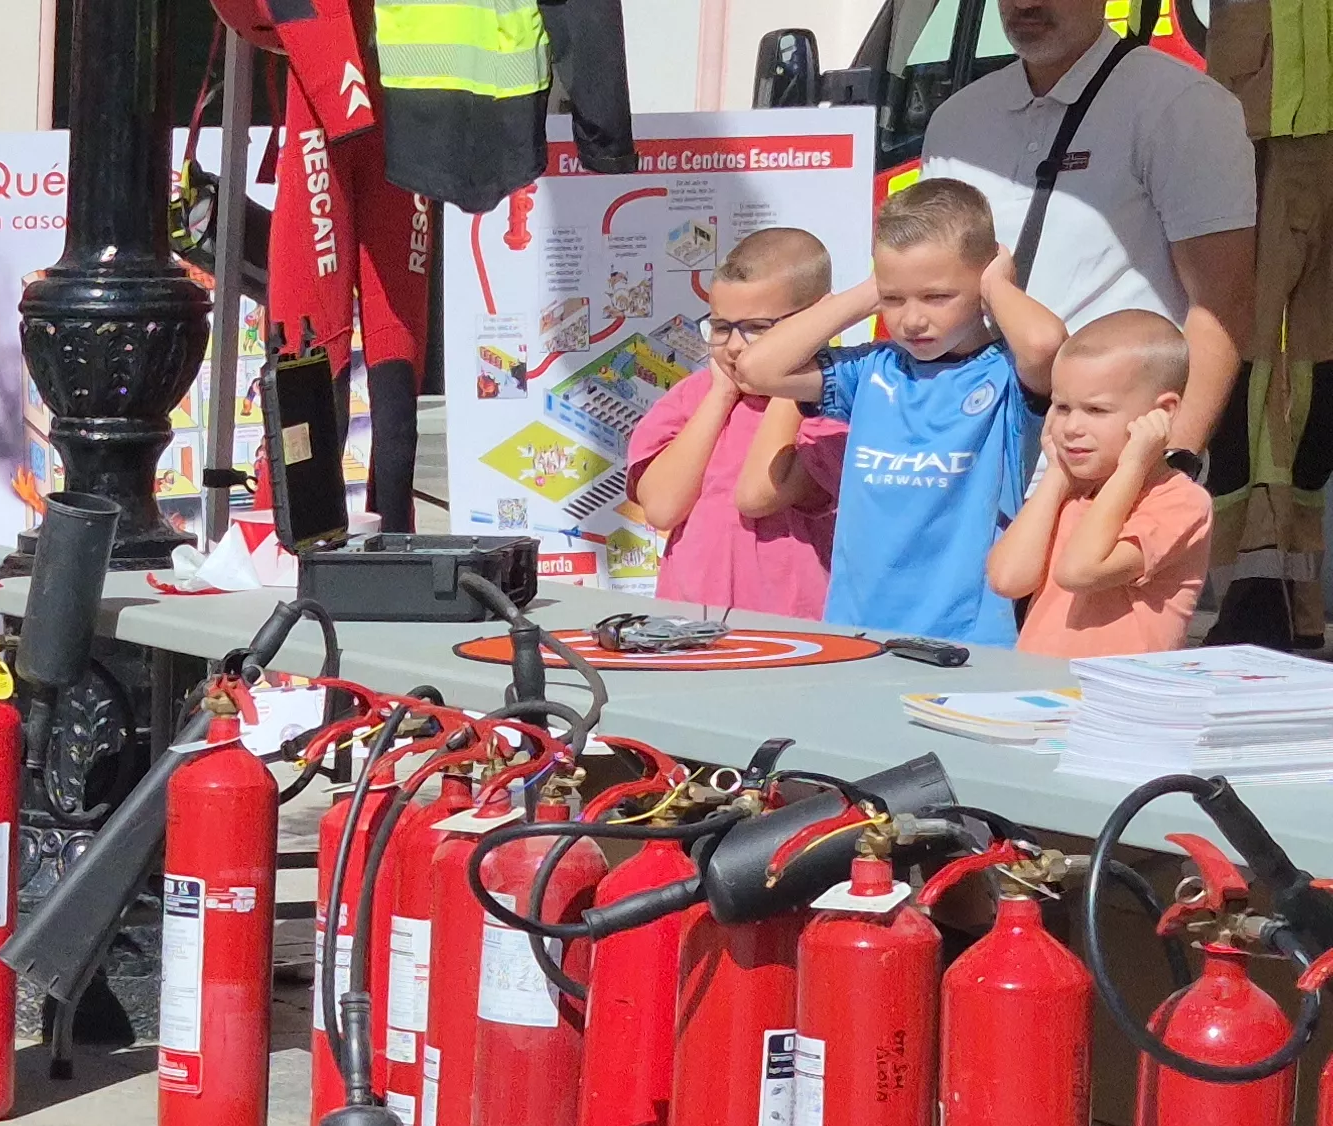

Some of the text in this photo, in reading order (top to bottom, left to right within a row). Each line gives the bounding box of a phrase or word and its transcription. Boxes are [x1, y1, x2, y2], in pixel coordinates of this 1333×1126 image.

[657, 151, 677, 170] de
[681, 150, 746, 171] Centros
[749, 147, 831, 169] Escolares
[299, 127, 338, 278] RESCATE
[12, 214, 67, 230] caso
[408, 192, 429, 275] RESC
[855, 446, 975, 474] ETIHAD
[863, 473, 949, 489] AIRWAYS
